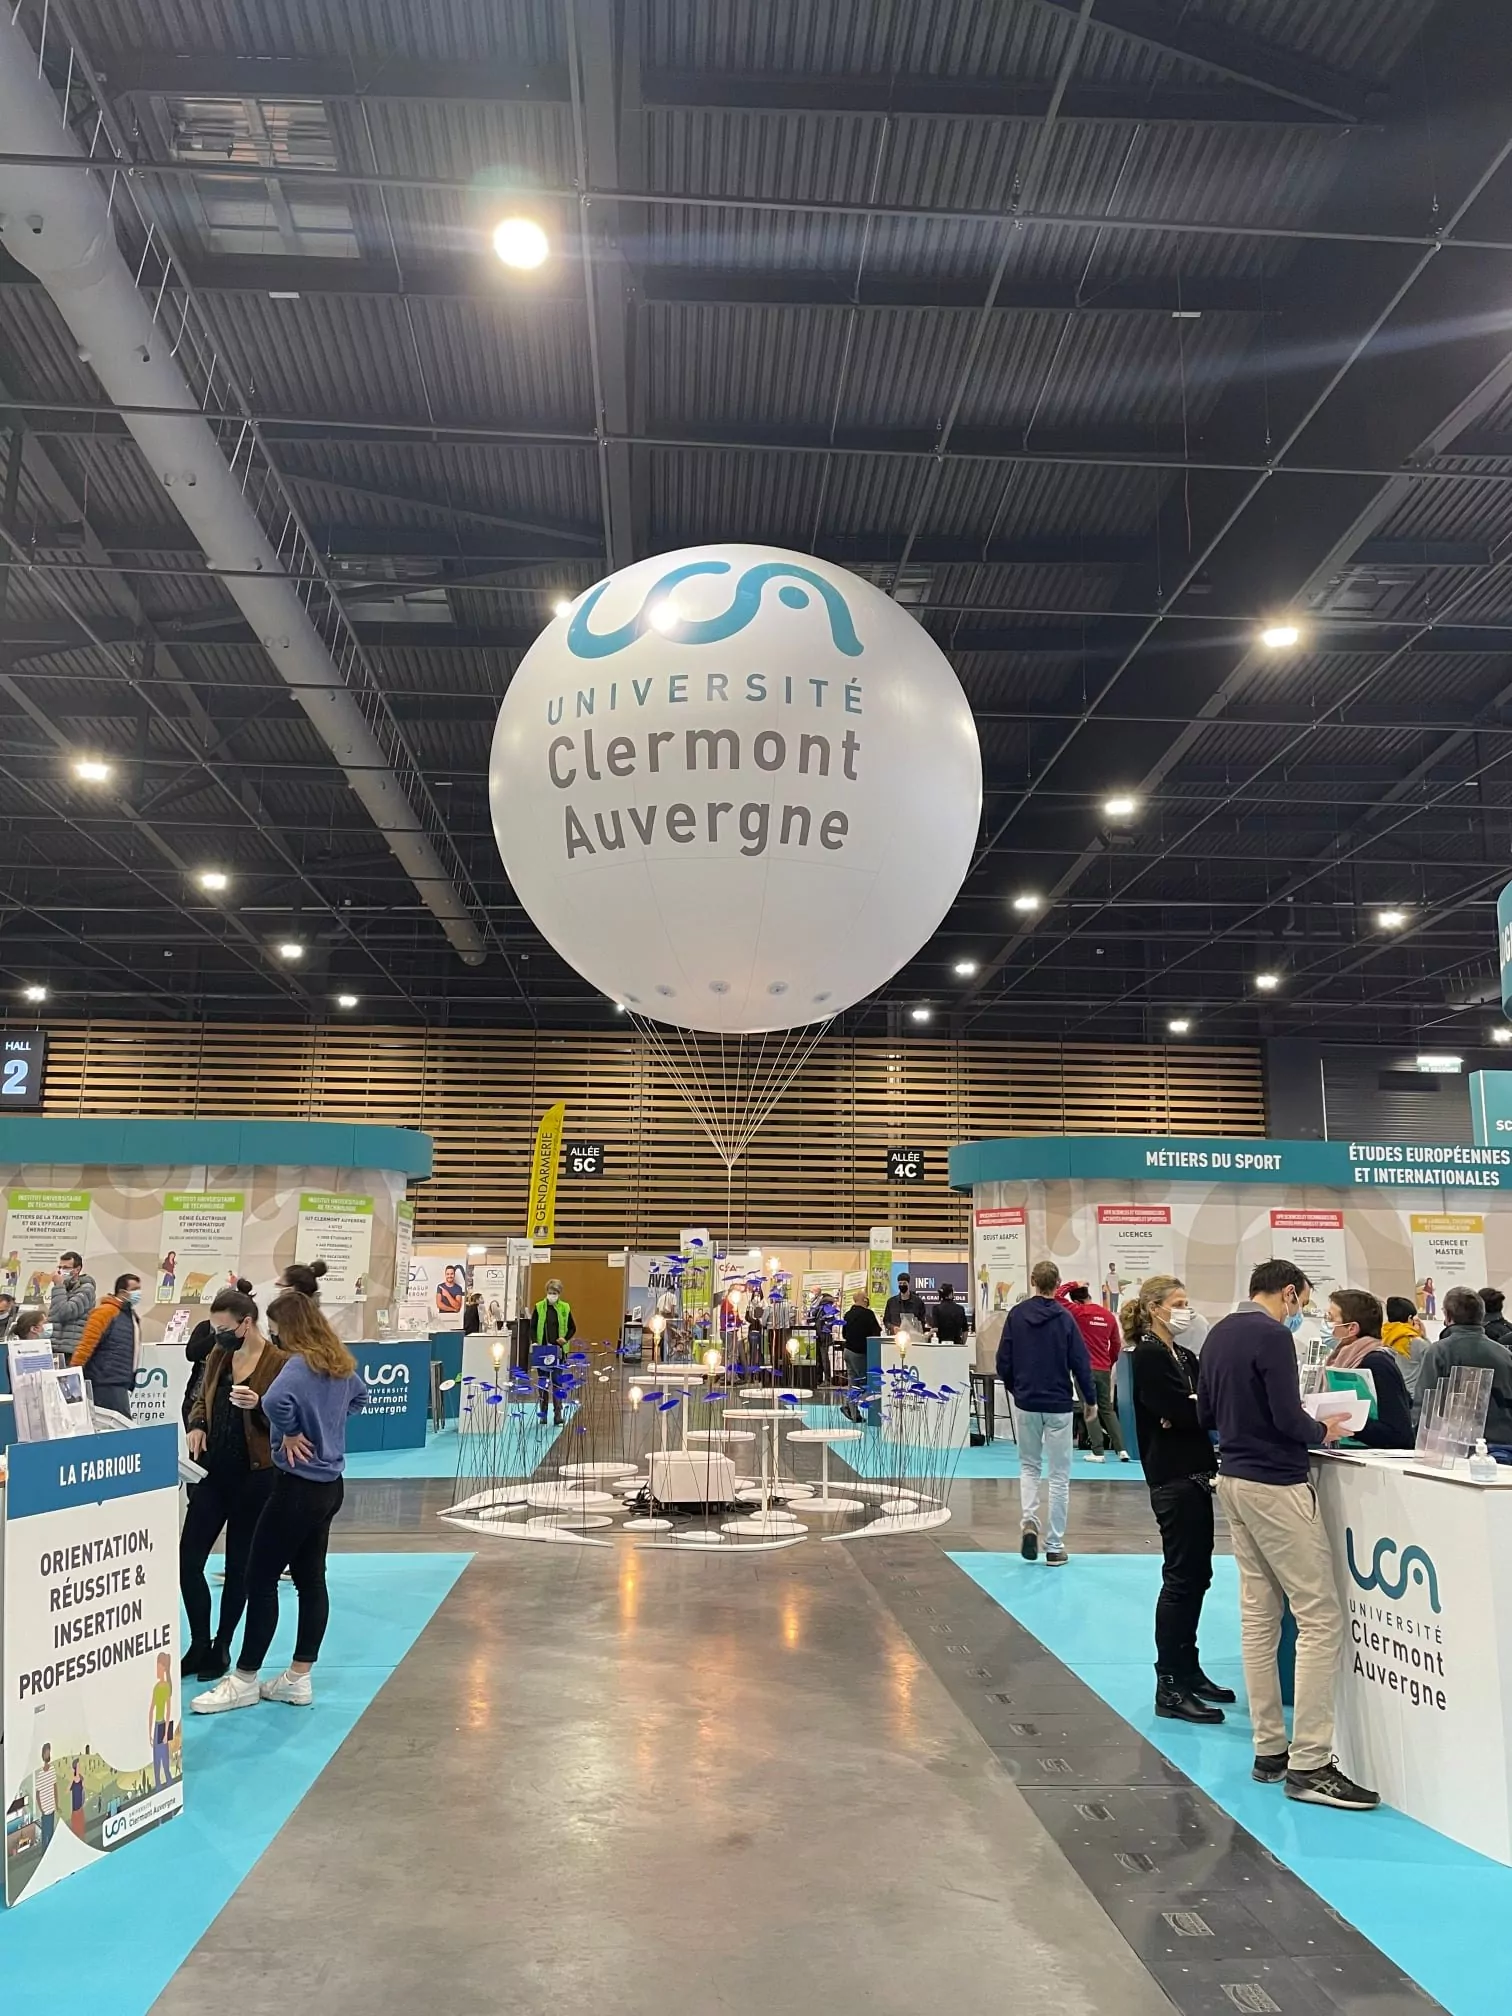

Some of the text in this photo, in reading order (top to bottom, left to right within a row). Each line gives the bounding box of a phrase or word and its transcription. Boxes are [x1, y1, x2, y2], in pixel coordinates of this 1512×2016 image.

[547, 673, 864, 725] UNIVERSITÉ
[548, 727, 862, 789] Clermont
[564, 801, 849, 858] Auvergne
[5, 1041, 31, 1051] HALL
[2, 1059, 29, 1095] 2
[570, 1146, 600, 1156] ALLÉE
[891, 1151, 920, 1162] ALLÉE
[1146, 1148, 1282, 1170] MÉTIERS DU SPORT
[1349, 1142, 1511, 1164] ÉTUDES EUROPÉENNES
[535, 1131, 553, 1221] GENDARMERIE
[573, 1158, 596, 1172] 5C
[894, 1163, 917, 1178] 4C
[1354, 1167, 1500, 1186] ET INTERNATIONALES
[915, 1277, 935, 1289] INFN
[368, 1386, 408, 1394] NIVERSITÉ
[368, 1394, 408, 1404] lermont
[130, 1400, 166, 1409] rmont
[131, 1411, 165, 1421] ergne
[361, 1405, 407, 1416] Auvergne
[59, 1453, 141, 1487] LA FABRIQUE
[40, 1528, 153, 1577] ORIENTATION,
[50, 1564, 146, 1613] RÉUSSITE &
[54, 1599, 142, 1649] INSERTION
[1349, 1598, 1443, 1644] UNIVERSITÉ
[1351, 1619, 1445, 1677] Clermont
[19, 1623, 171, 1700] PROFESSIONNELLE
[1353, 1651, 1446, 1711] Auvergne
[129, 1809, 153, 1827] Clermont
[153, 1797, 176, 1814] Auvergne
